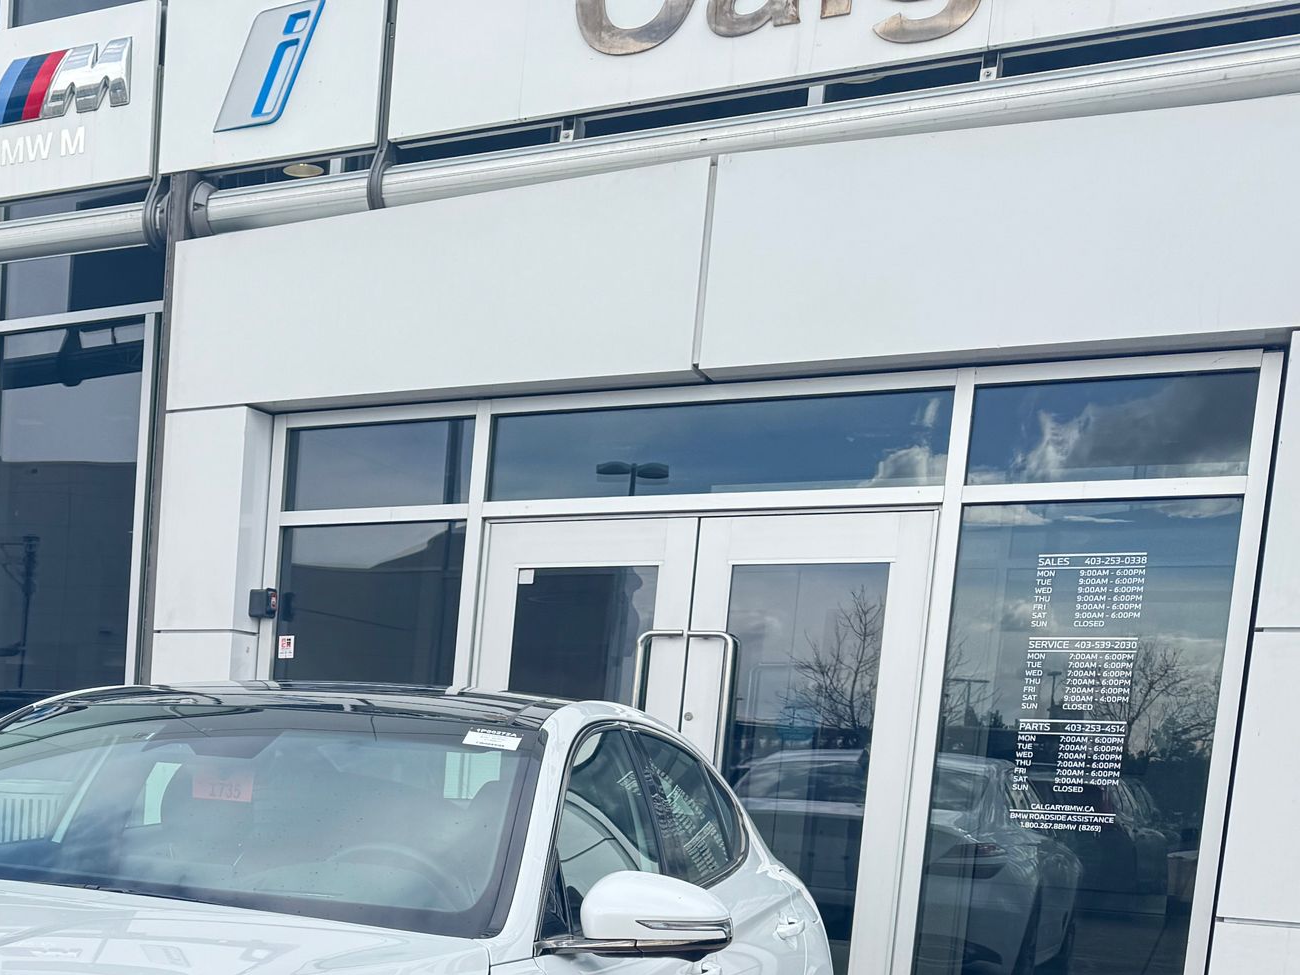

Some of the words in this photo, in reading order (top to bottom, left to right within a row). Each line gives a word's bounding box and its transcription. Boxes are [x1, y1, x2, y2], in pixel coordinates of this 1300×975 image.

[60, 126, 86, 157] M
[1030, 804, 1095, 812] CALGARYBMW.CA
[1029, 813, 1066, 821] ROADSIDE
[1067, 815, 1114, 823] ASSISTANCE
